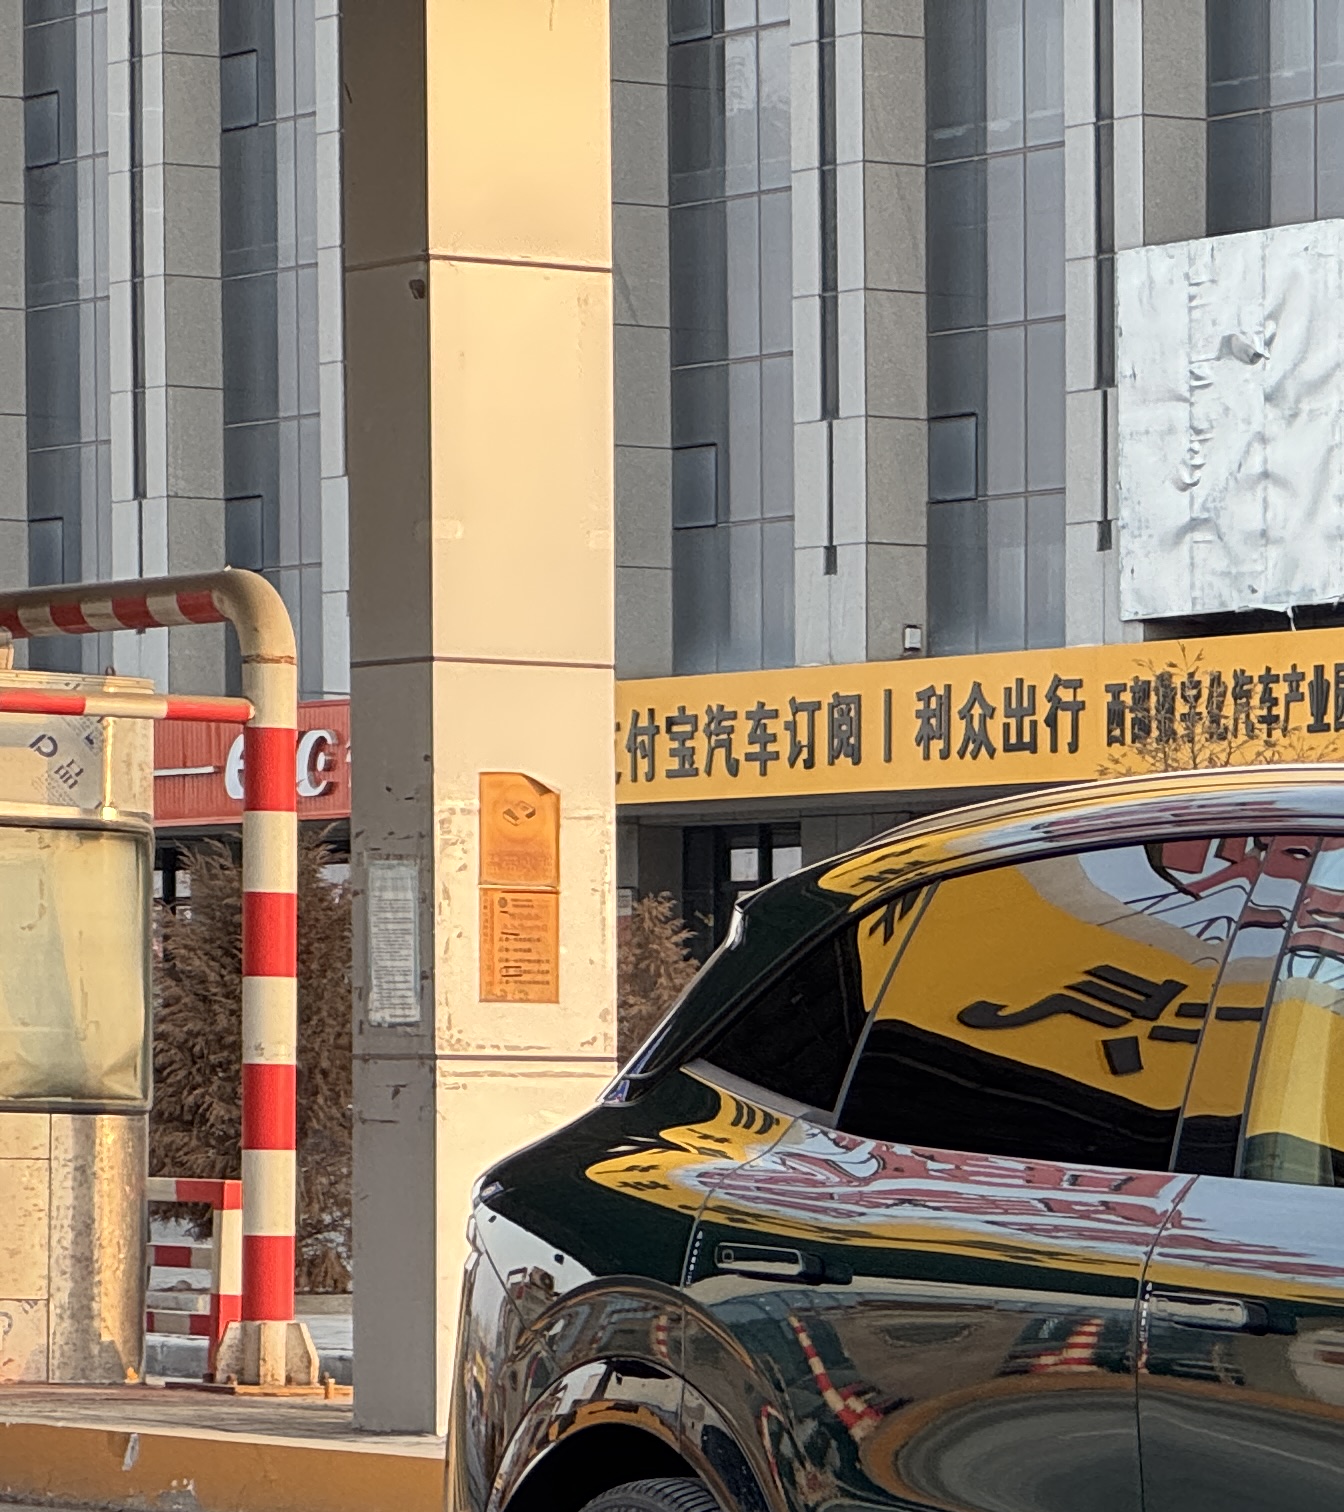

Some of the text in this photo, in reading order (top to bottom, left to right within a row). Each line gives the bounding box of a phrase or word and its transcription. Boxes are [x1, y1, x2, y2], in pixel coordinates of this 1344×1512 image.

[616, 692, 862, 784] 付宝汽车订阅
